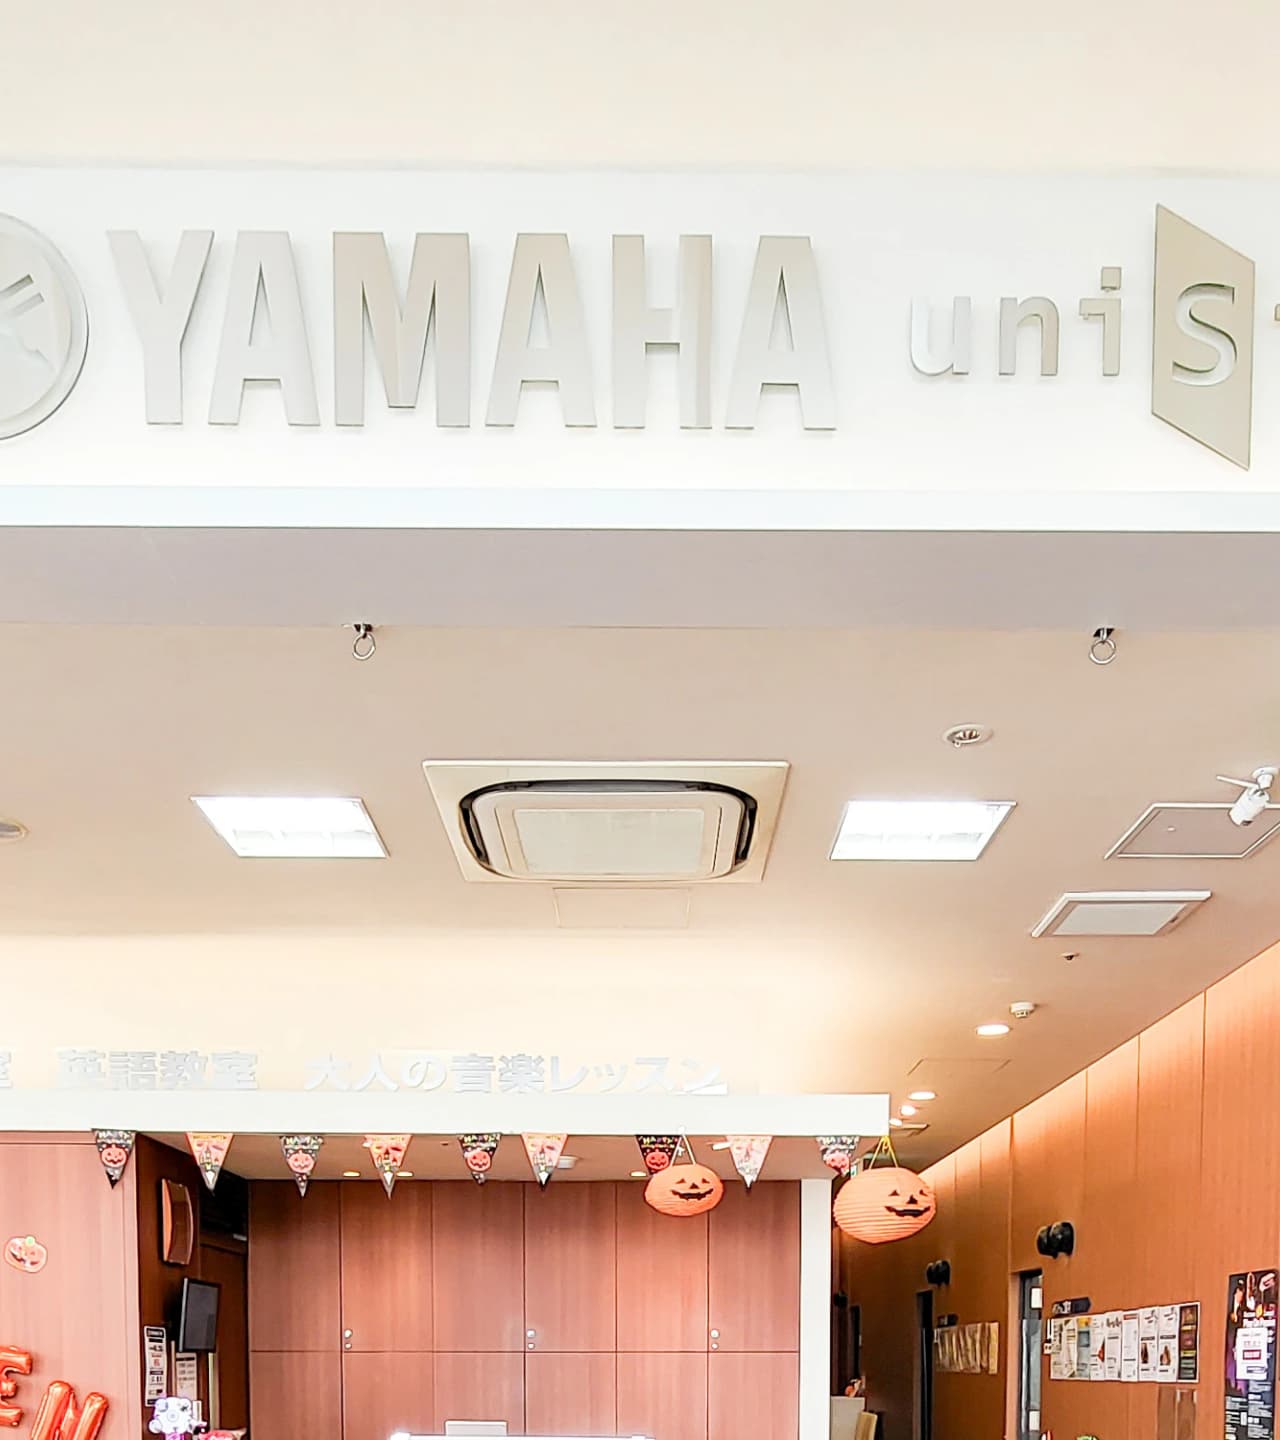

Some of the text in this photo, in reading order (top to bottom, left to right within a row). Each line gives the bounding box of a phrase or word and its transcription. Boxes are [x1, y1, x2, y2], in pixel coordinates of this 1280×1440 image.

[106, 229, 837, 430] YAMAHA
[57, 1047, 258, 1090] 英語教室
[303, 1052, 728, 1095] 大人の音楽レッスン
